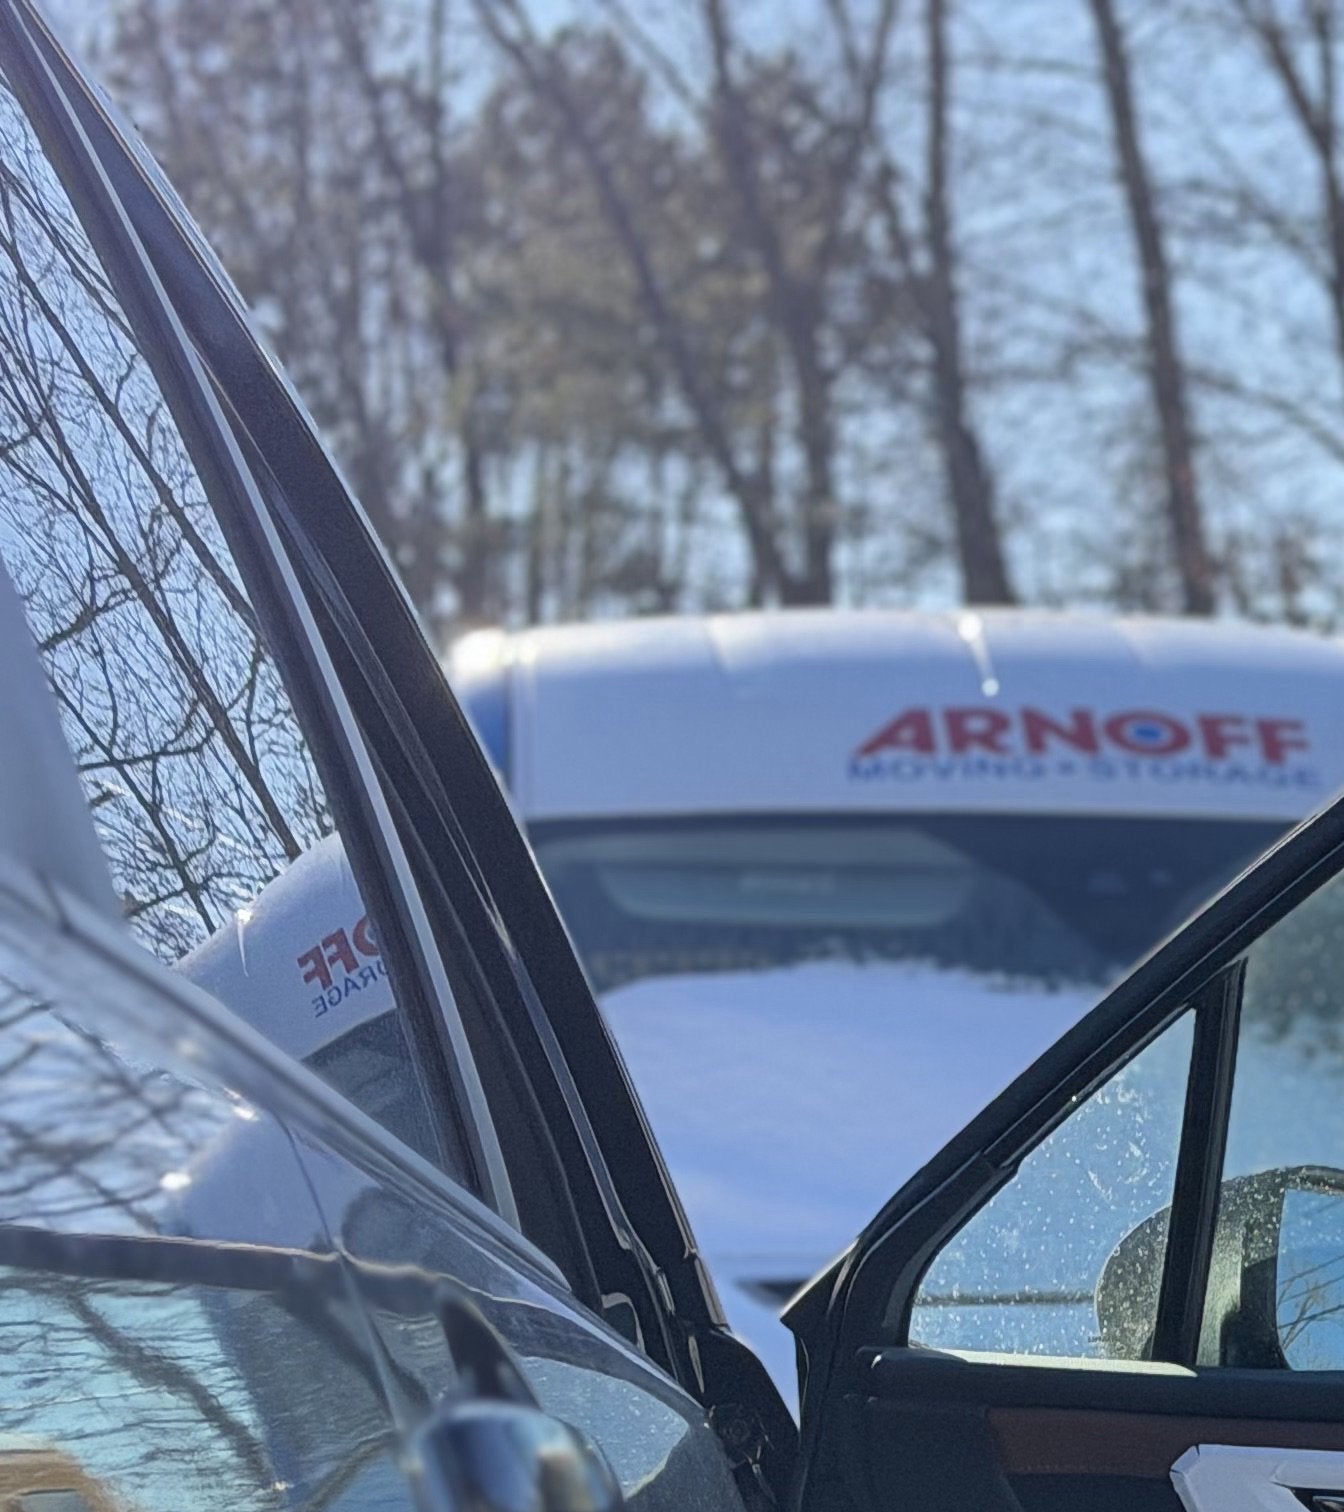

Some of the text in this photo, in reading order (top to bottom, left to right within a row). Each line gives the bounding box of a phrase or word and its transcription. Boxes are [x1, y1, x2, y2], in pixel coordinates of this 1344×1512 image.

[852, 705, 1311, 766] ARNOFF
[847, 756, 1322, 790] MOVING STORAGE
